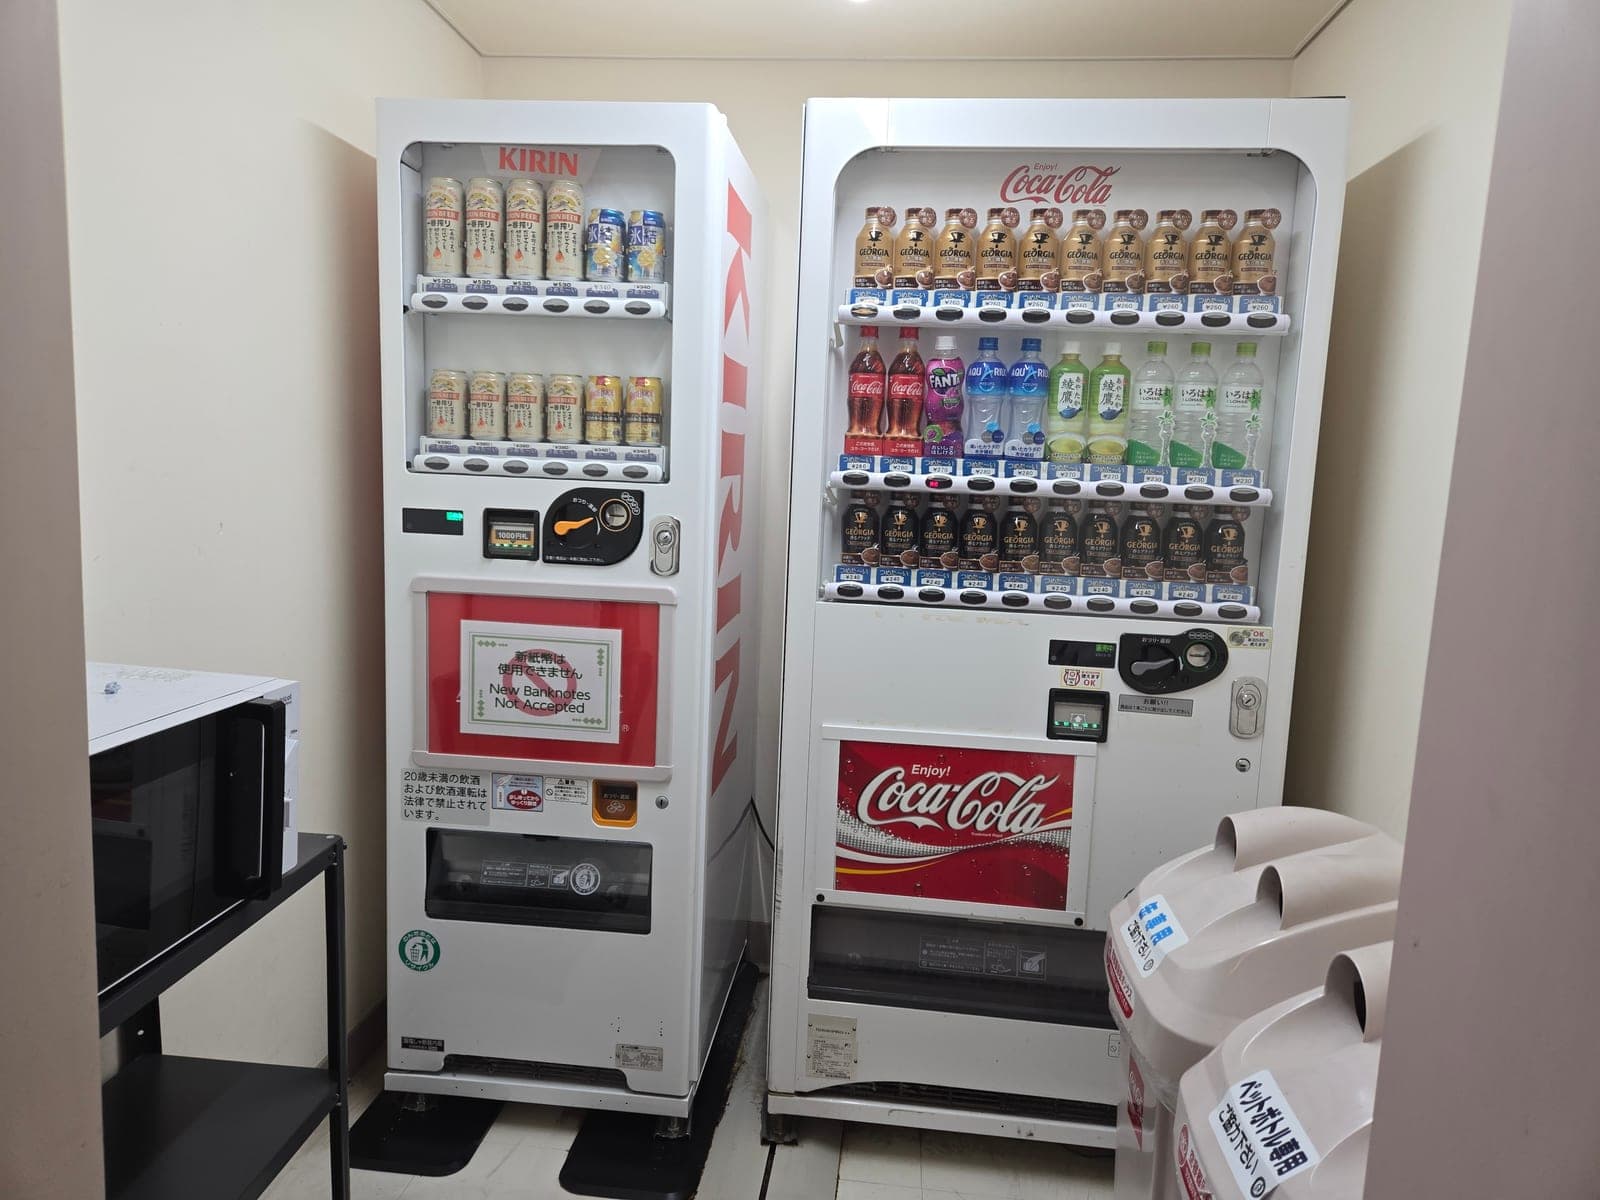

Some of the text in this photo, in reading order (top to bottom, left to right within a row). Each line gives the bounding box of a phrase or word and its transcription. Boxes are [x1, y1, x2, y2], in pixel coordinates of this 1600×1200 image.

[500, 146, 578, 176] KIRIN
[1033, 162, 1058, 171] Enjoy!
[1000, 165, 1122, 204] Coca-Cola
[860, 247, 889, 257] GEORGIA
[900, 247, 930, 258] GEORGIA
[940, 248, 971, 258] GEORGIA
[981, 249, 1012, 258] GEORGIA
[1023, 249, 1054, 258] GEORGIA
[1067, 250, 1098, 259] GEORGIA
[1110, 250, 1141, 261] GEORGIA
[1153, 251, 1185, 261] GEORGIA
[1195, 251, 1228, 262] GEORGIA
[1238, 252, 1272, 262] GEORGIA
[852, 381, 883, 395] Coca-Cola
[891, 381, 922, 396] Coca-Cola
[1060, 379, 1074, 405] 綾鷹
[1101, 380, 1115, 406] 綾鷹
[711, 177, 753, 795] KIRIN
[845, 528, 874, 536] GEORGIA
[884, 530, 913, 538] GEORGIA
[1044, 536, 1074, 544] GEORGIA
[1085, 538, 1114, 546] GEORGIA
[1126, 541, 1157, 549] GEORGIA
[1168, 543, 1200, 551] GEORGIA
[1211, 545, 1242, 553] GEORGIA
[1253, 630, 1265, 638] OK
[515, 650, 566, 665] 新紙幣は
[498, 663, 583, 680] 使用できません
[1083, 679, 1097, 687] OK
[489, 683, 591, 701] New Banknotes
[495, 697, 585, 715] Not Accepted
[911, 764, 951, 778] Enjoy!
[404, 771, 481, 786] 20歳未満の飲酒
[404, 783, 487, 799] および飲酒運転は
[404, 796, 487, 811] 法律で禁止されて
[857, 766, 1061, 834] Coca-Cola
[404, 810, 440, 822] います。
[1239, 1080, 1309, 1177] ペットボトル専用
[1219, 1103, 1260, 1175] ご協力下さい
